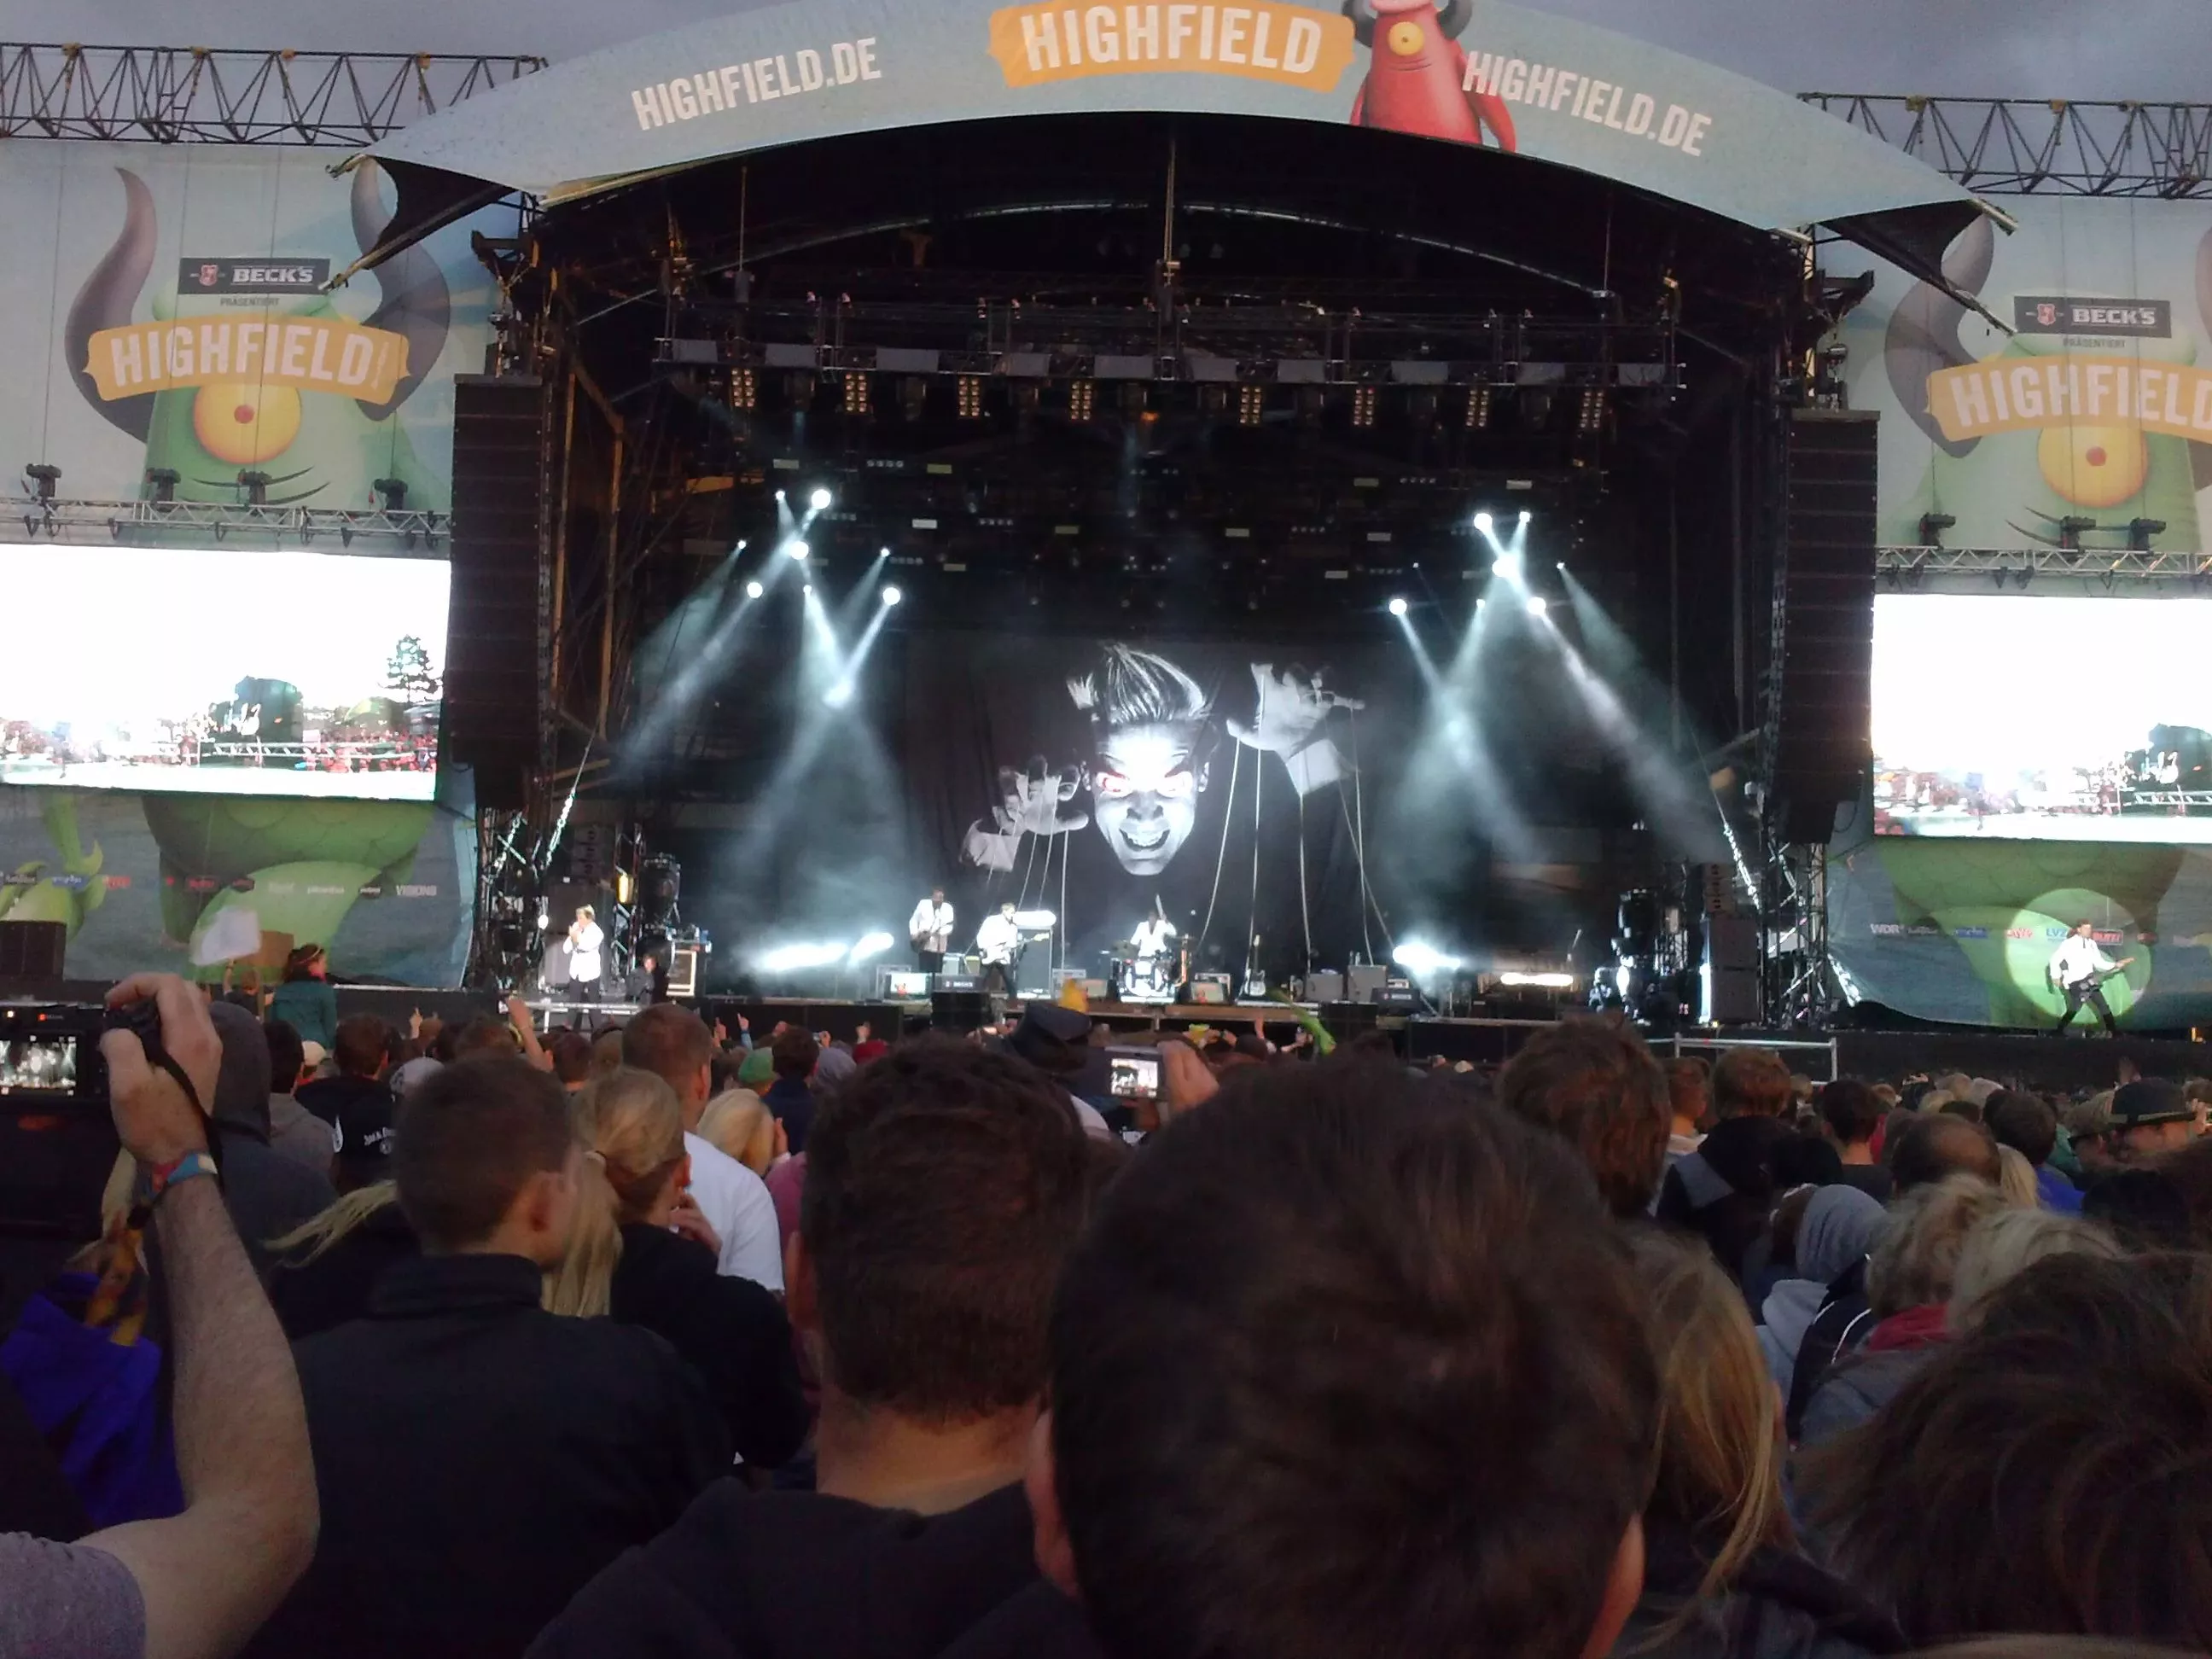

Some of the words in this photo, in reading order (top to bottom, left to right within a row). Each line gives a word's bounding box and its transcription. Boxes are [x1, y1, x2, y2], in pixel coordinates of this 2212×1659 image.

[1021, 5, 1322, 73] HIGHFIELD
[632, 38, 882, 131] HIGHFIELD.DE
[1462, 50, 1712, 157] HIGHFIELD.DE
[233, 266, 313, 282] BECK'S
[2072, 307, 2157, 325] BECK'S
